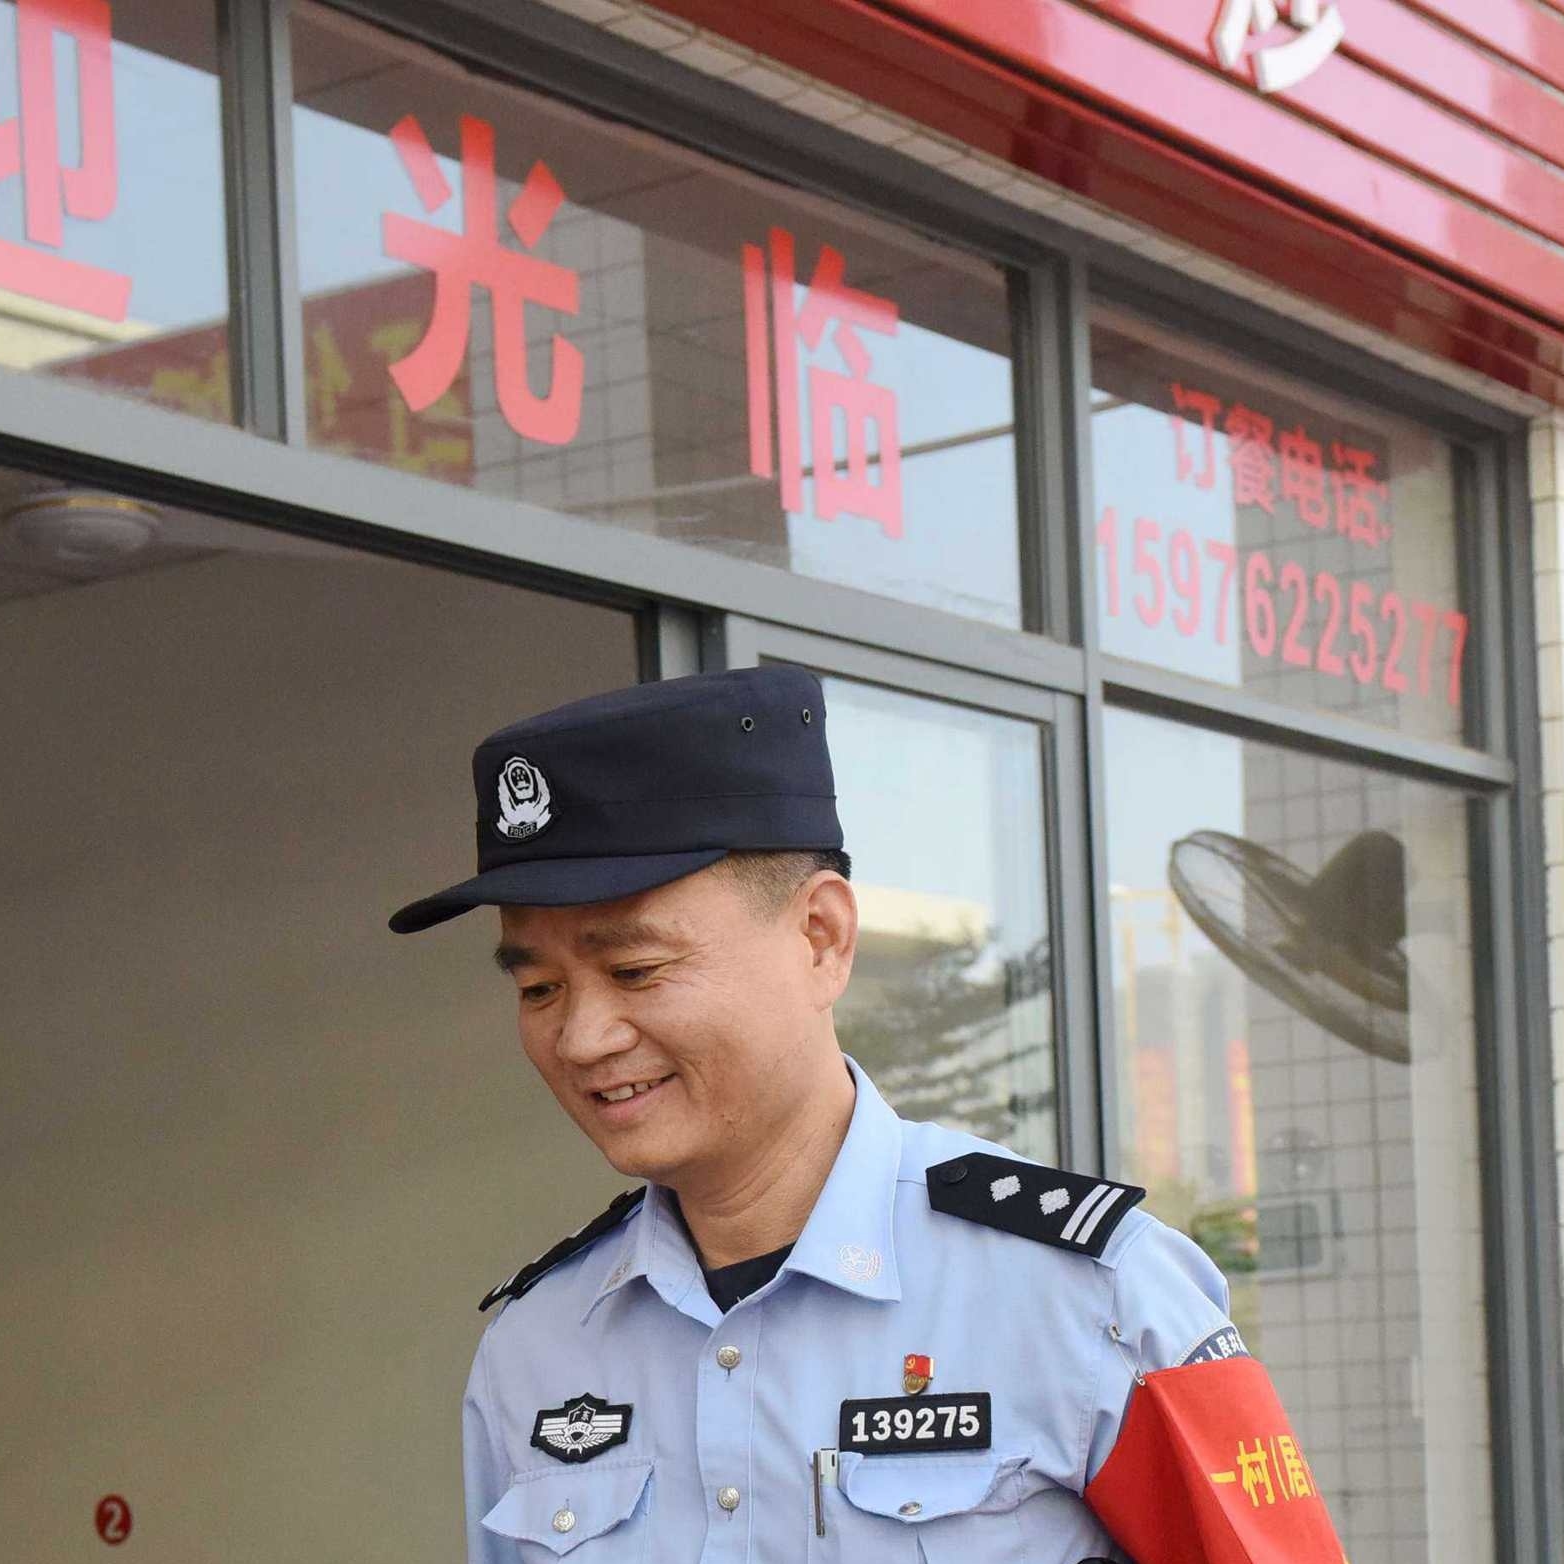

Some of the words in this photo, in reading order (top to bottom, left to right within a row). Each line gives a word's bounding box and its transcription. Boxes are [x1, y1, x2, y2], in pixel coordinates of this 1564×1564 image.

[1168, 382, 1393, 549] 订餐电话
[1096, 506, 1469, 705] 15976225277
[851, 1405, 981, 1443] 139275
[103, 1501, 125, 1539] 2
